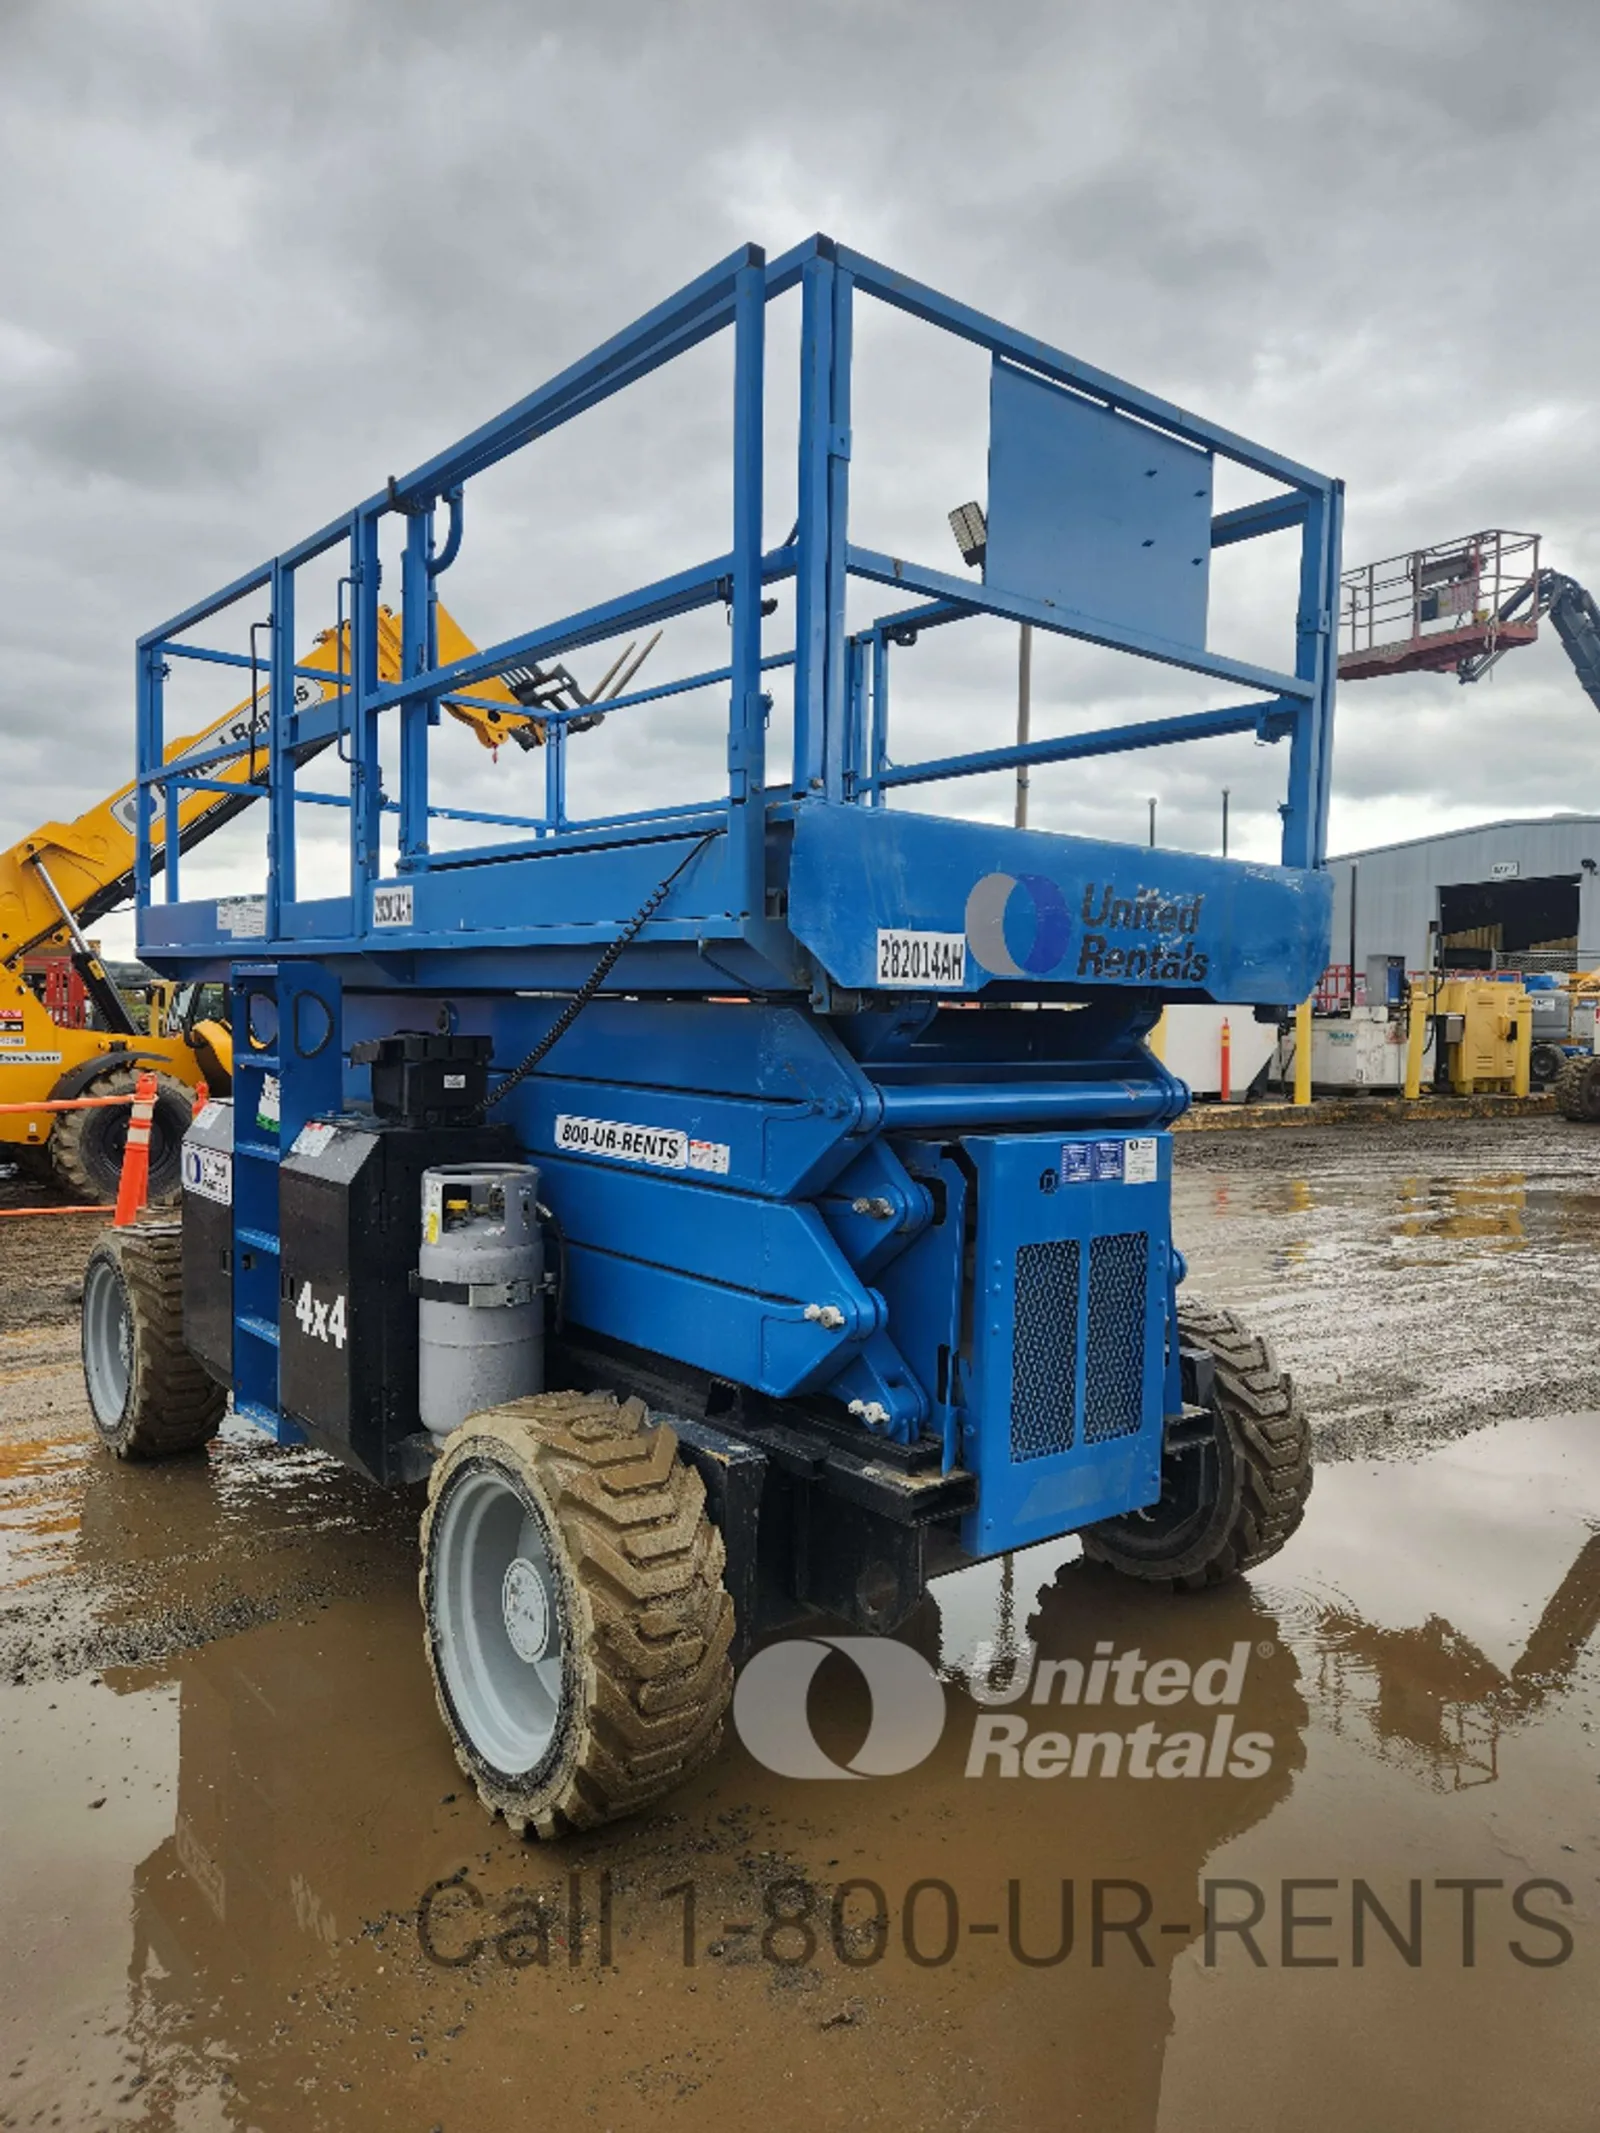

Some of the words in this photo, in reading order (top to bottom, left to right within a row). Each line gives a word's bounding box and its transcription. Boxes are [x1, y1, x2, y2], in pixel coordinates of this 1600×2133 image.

[1081, 883, 1205, 935] United
[880, 937, 962, 981] 282014AH
[1077, 934, 1210, 982] Rentals
[562, 1123, 679, 1160] 800-UR-RENTS
[295, 1280, 348, 1350] 4x4
